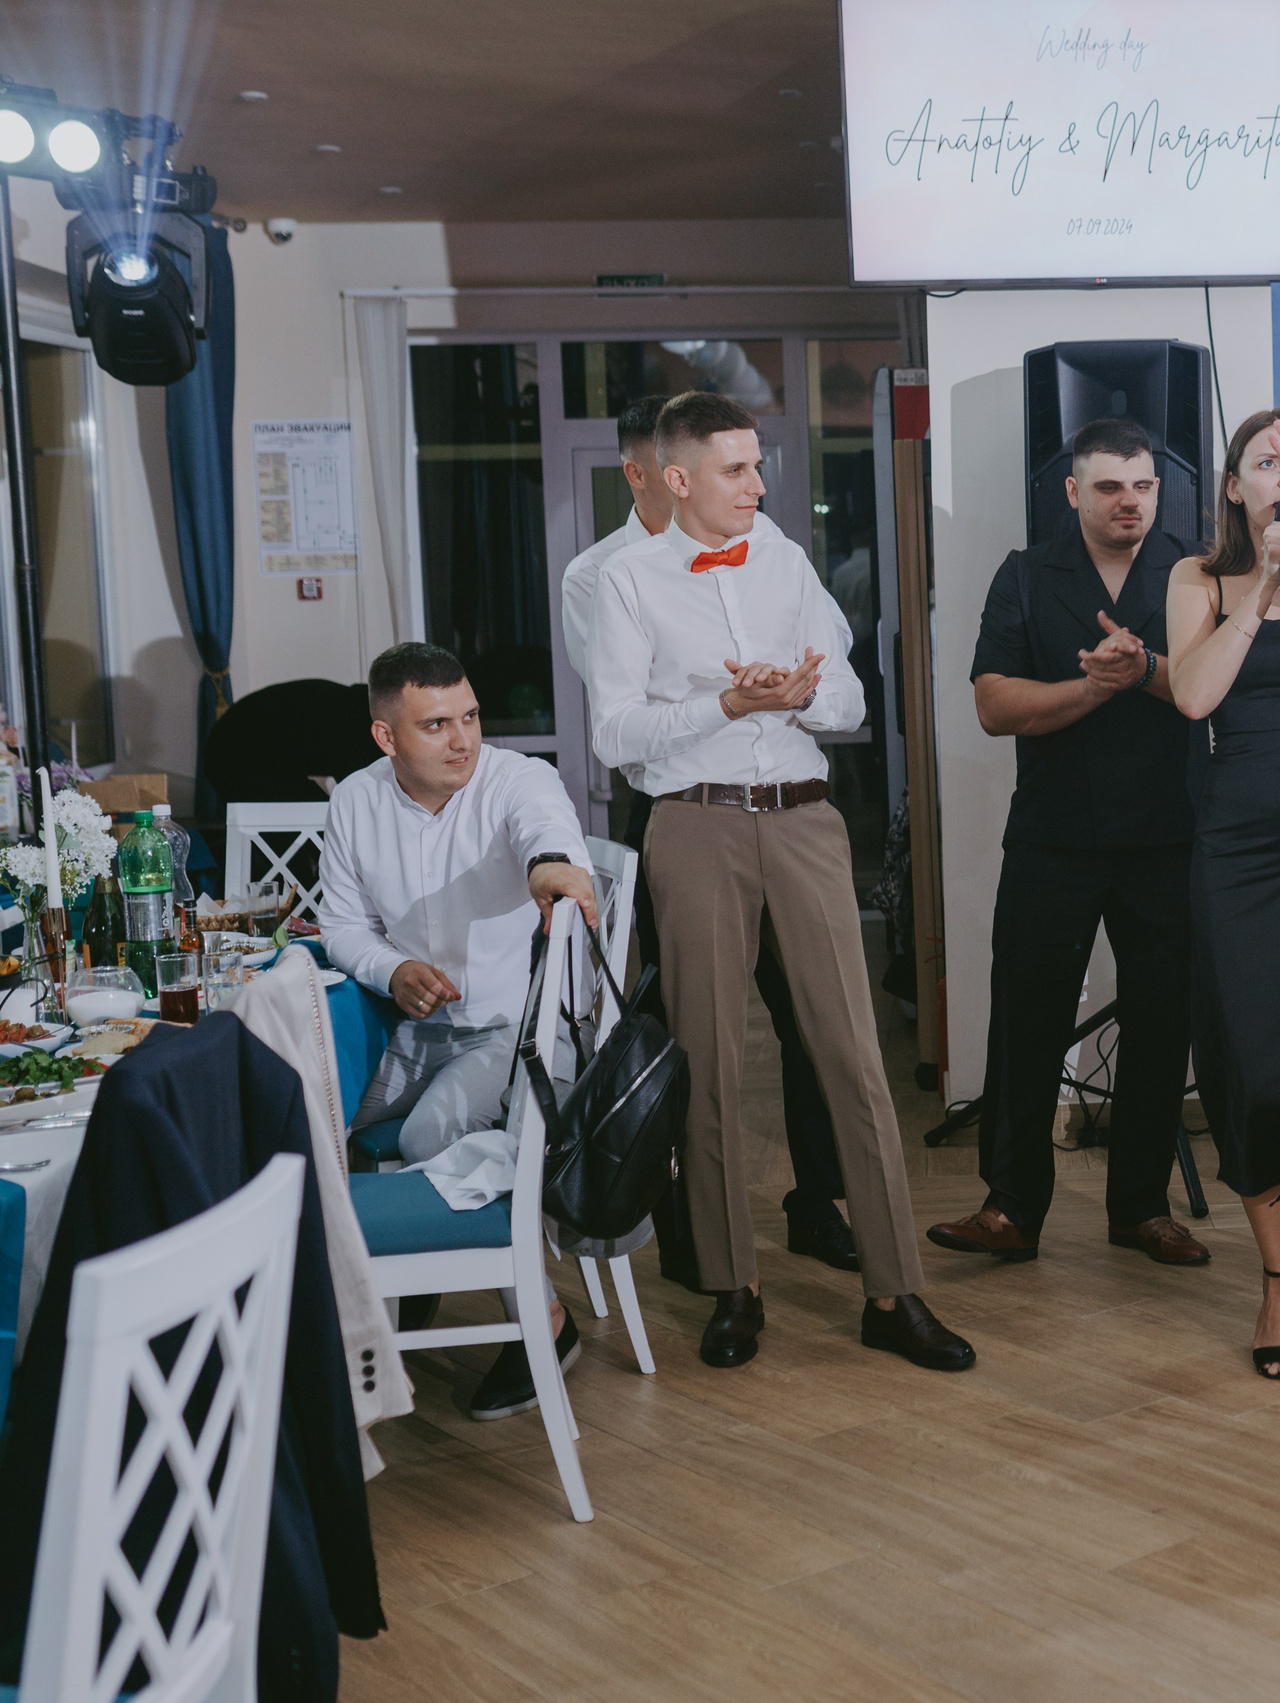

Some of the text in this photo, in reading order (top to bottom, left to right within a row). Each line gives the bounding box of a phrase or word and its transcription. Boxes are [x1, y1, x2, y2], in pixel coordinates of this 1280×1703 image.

[1036, 25, 1149, 72] Wedding day
[1058, 122, 1080, 156] &
[1066, 217, 1133, 236] 07.09.2024
[254, 422, 352, 434] ПЛАН ЭВАКУАЦИИ
